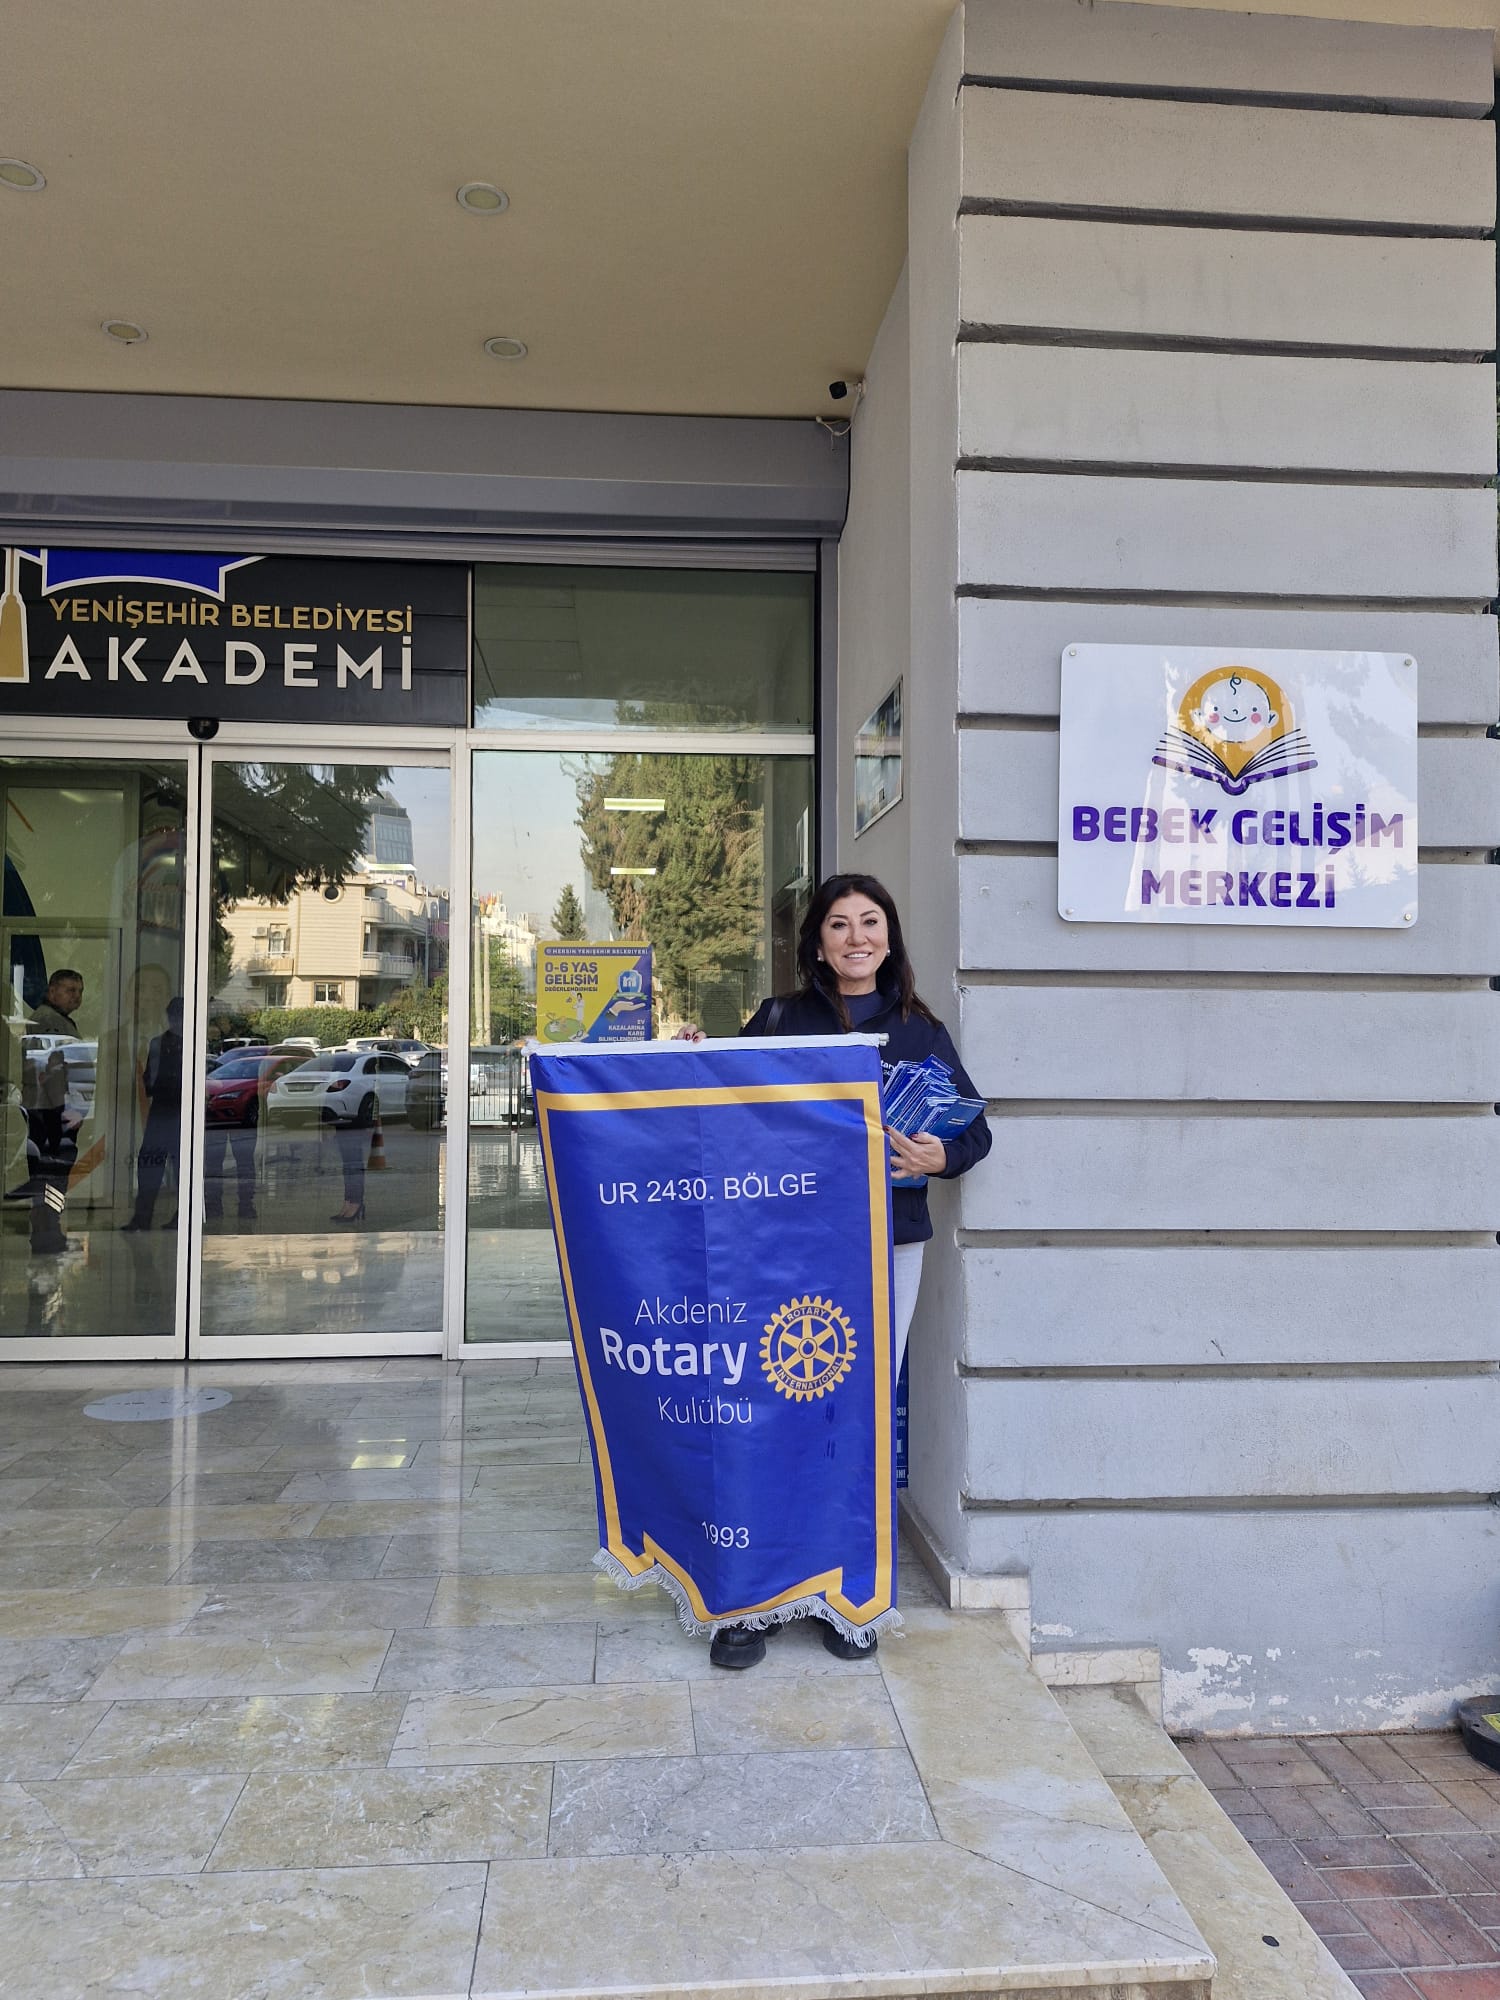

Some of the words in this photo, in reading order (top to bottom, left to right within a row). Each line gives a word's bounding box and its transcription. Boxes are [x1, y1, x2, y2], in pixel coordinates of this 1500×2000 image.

[49, 594, 220, 629] YENİŞEHİR
[231, 602, 413, 633] BELEDİYESİ
[44, 634, 413, 691] AKADEMİ
[1072, 805, 1218, 845] BEBEK
[1231, 802, 1405, 856] GELİŞİM
[1141, 864, 1336, 909] MERKEZİ
[545, 961, 569, 973] 0-6
[571, 962, 598, 975] YAŞ
[545, 974, 599, 986] GELİŞİM
[599, 1182, 638, 1206] UR
[646, 1179, 715, 1204] 2430.
[723, 1172, 818, 1200] BÖLGE
[634, 1296, 748, 1326] Akdeniz
[786, 1306, 827, 1322] ROTARY
[599, 1327, 748, 1386] Rotary
[776, 1360, 843, 1391] INTERNATIONAL
[657, 1395, 753, 1425] Kulübü
[701, 1520, 751, 1550] 1993
